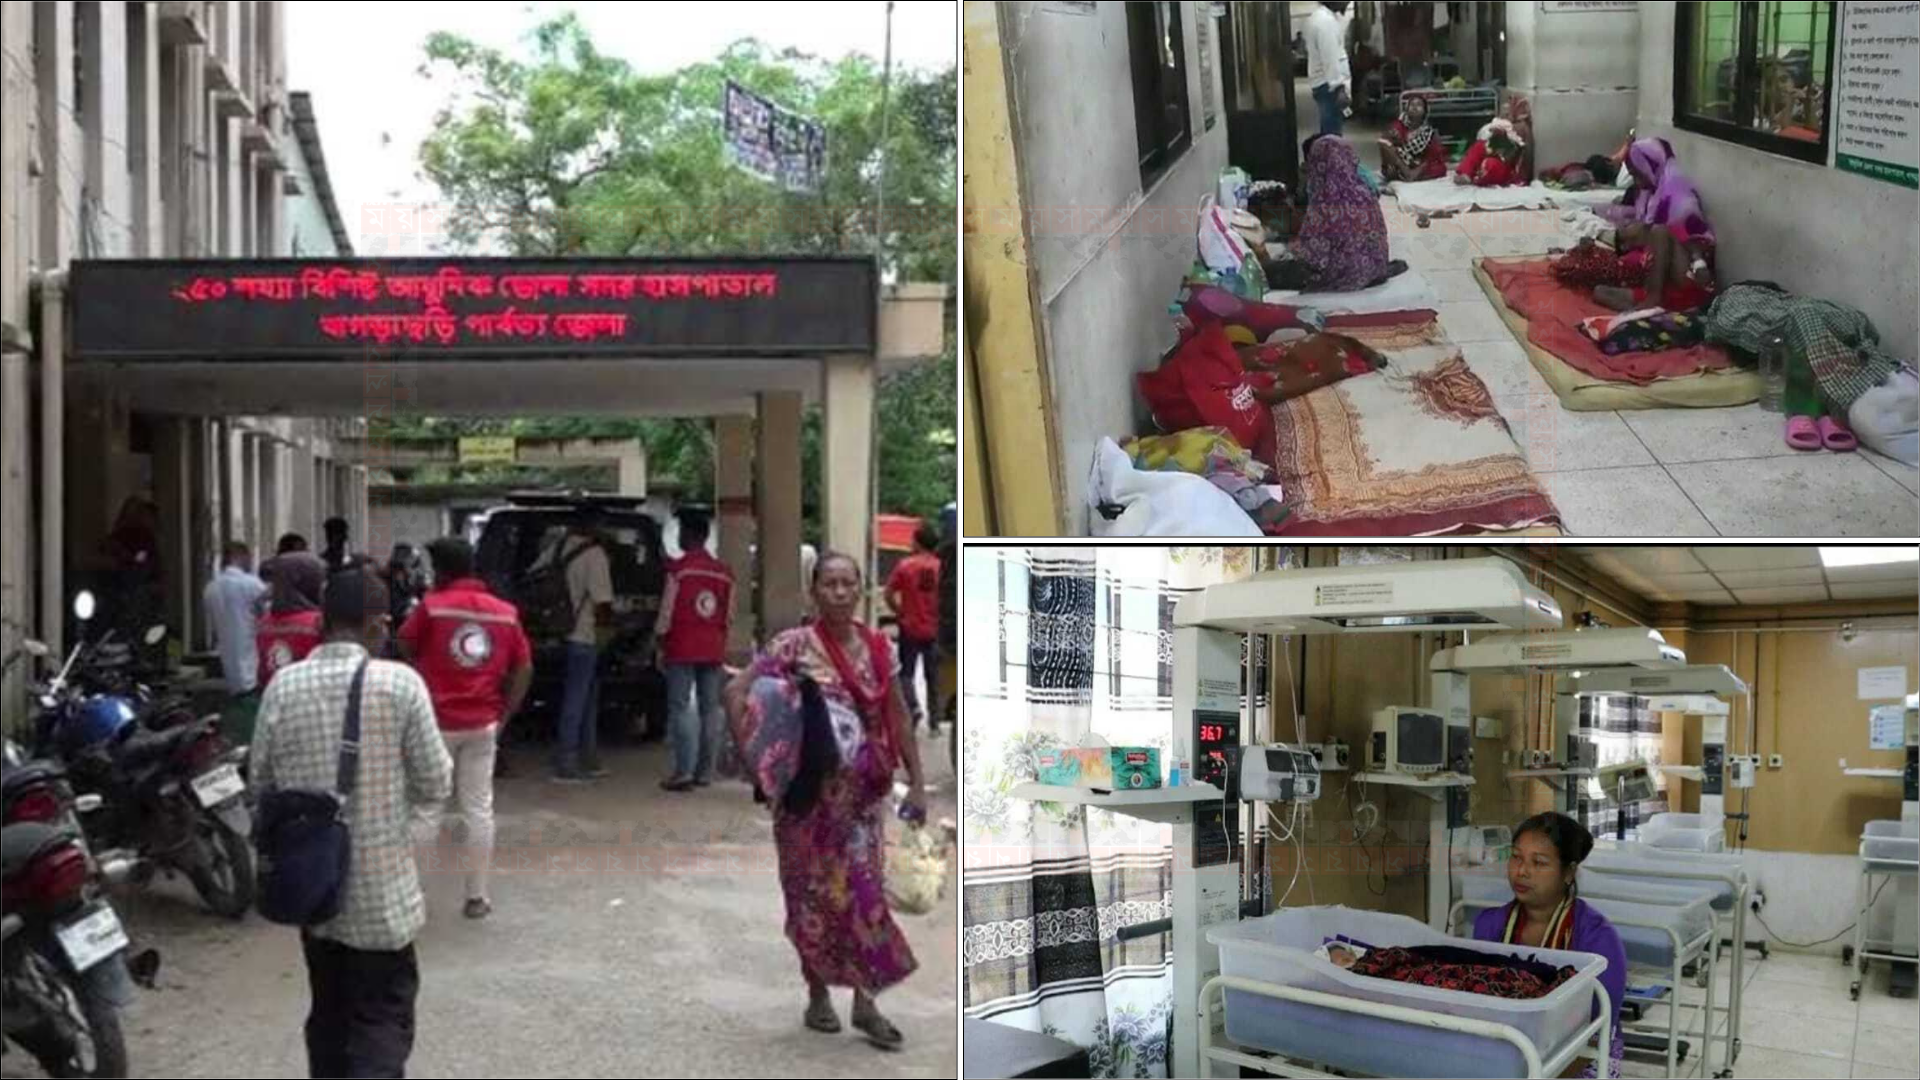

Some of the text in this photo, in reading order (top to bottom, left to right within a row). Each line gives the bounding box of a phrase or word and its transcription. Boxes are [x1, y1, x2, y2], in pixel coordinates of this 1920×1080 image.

[386, 267, 492, 306] আধুনিক
[499, 273, 570, 299] জেলা
[641, 272, 776, 298] হাসপাতাল
[465, 306, 547, 337] পার্বত্য
[554, 313, 627, 342] জেলা
